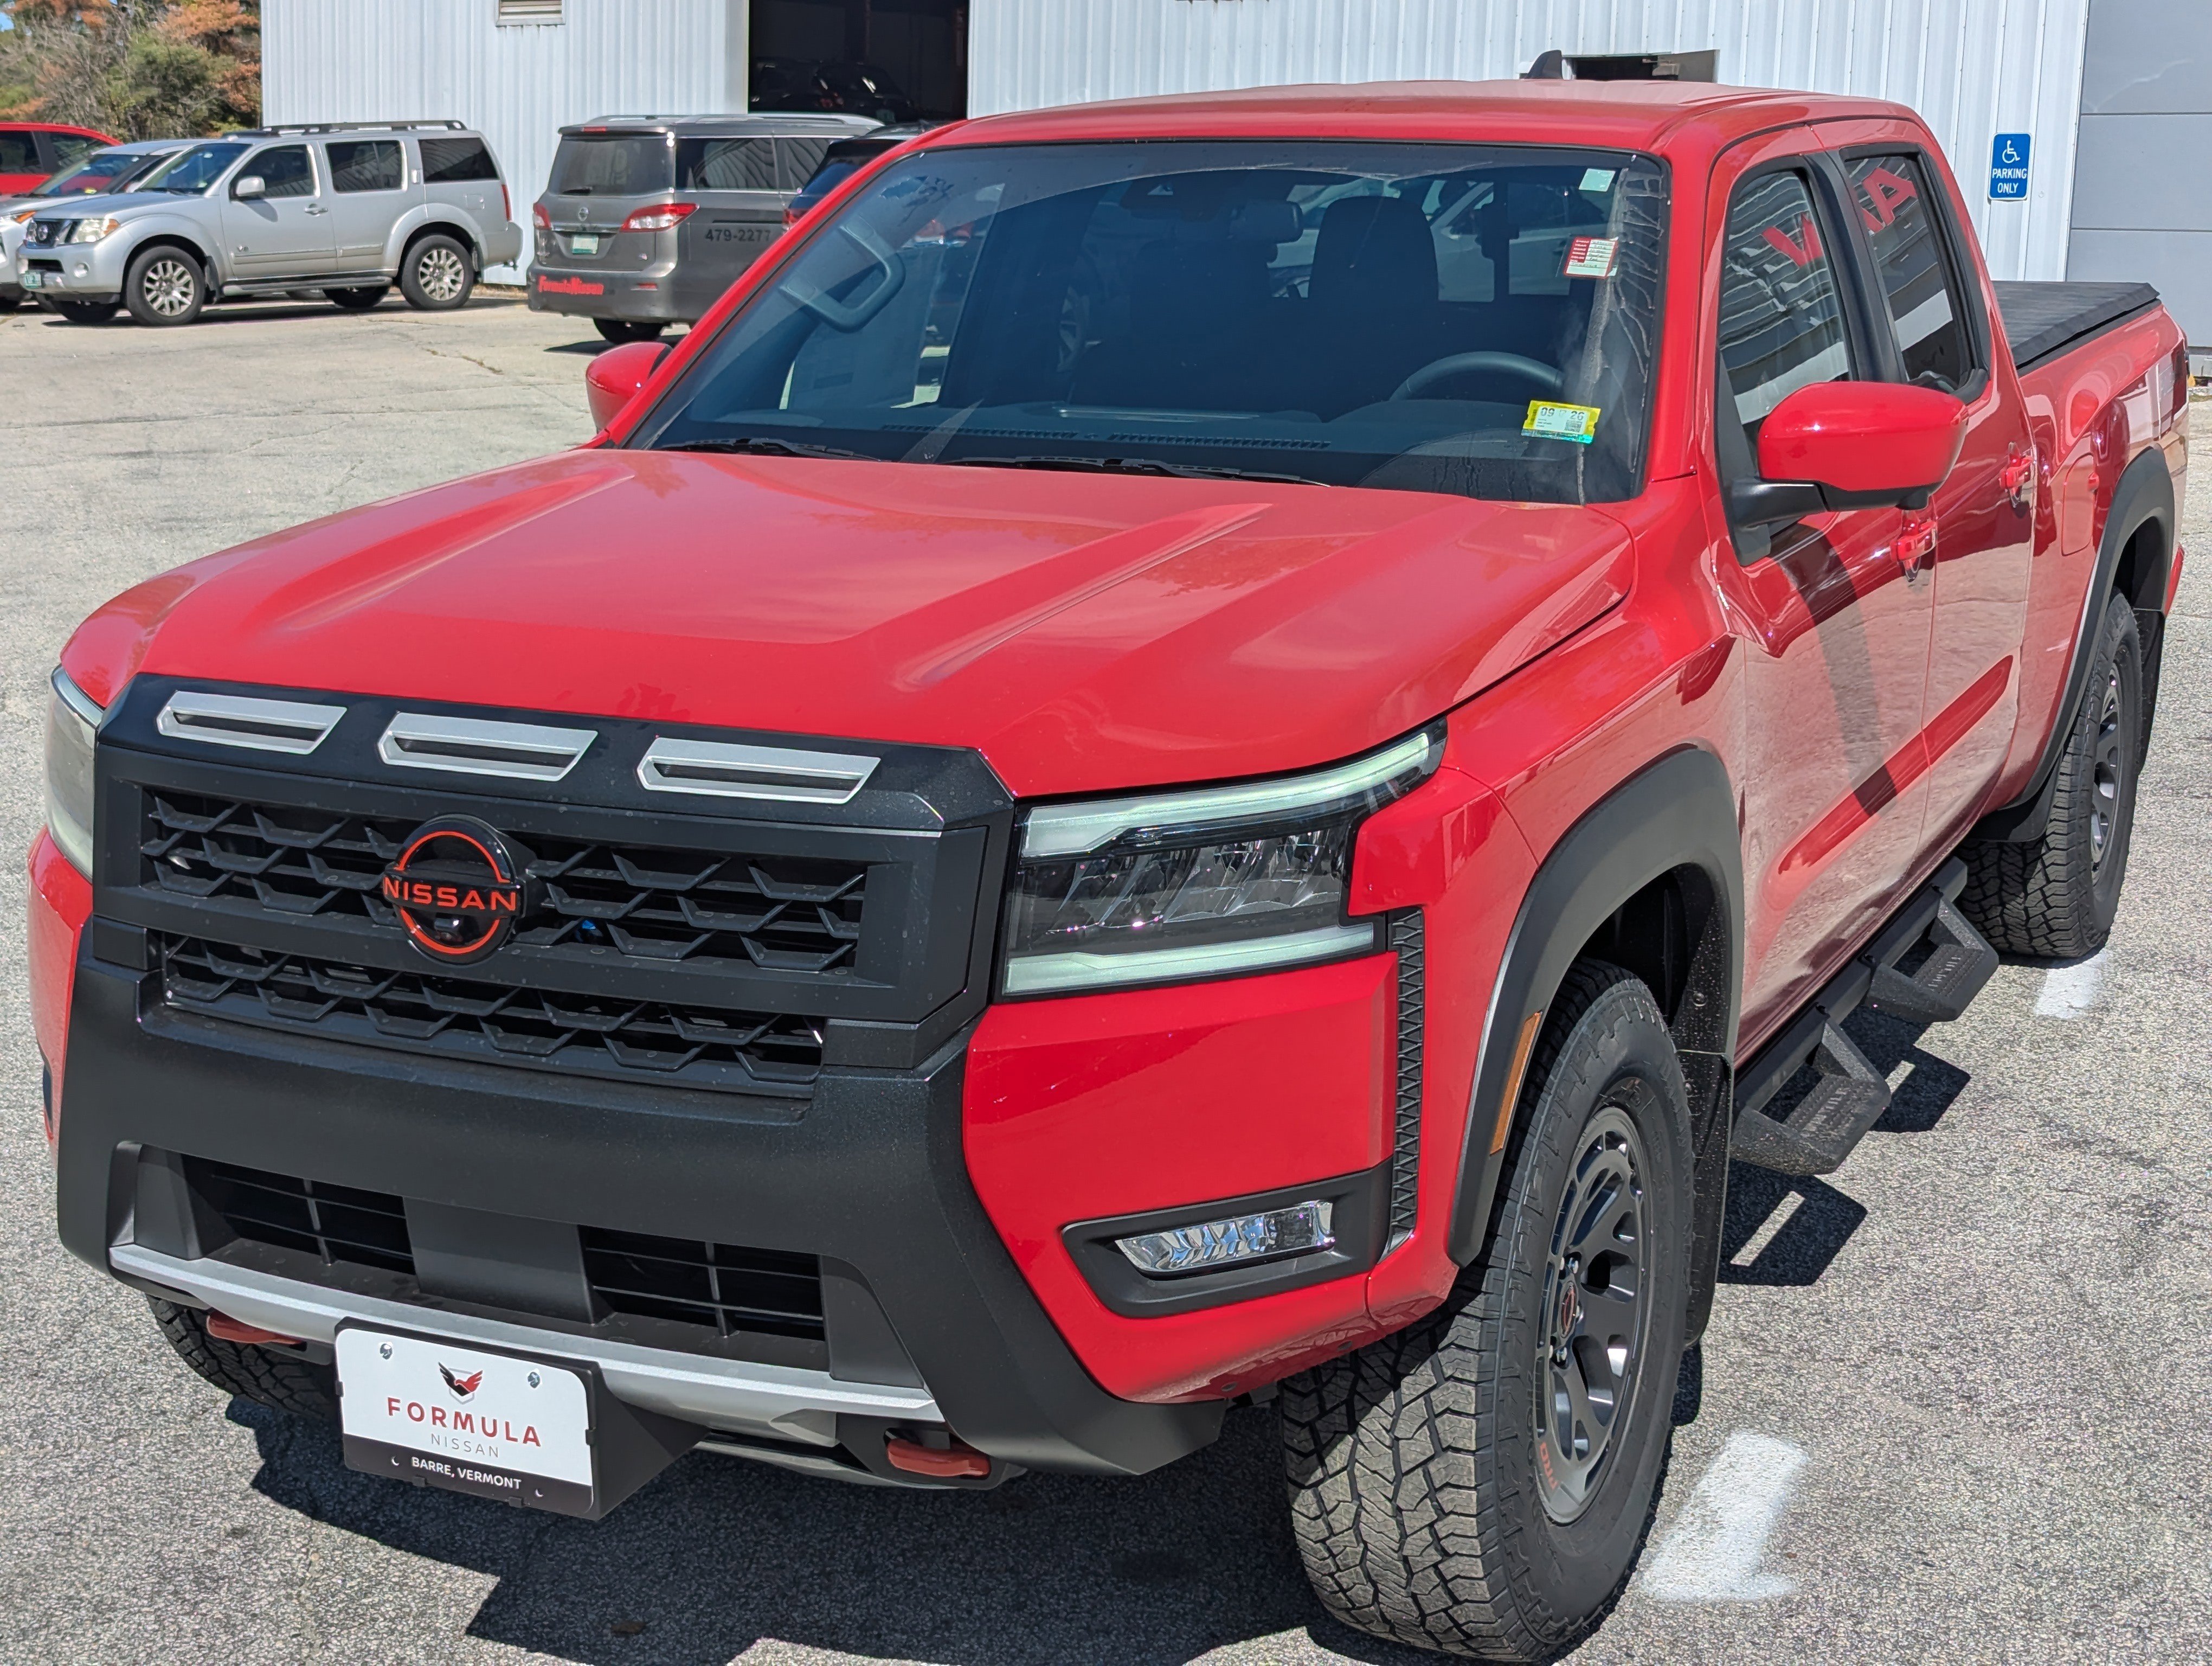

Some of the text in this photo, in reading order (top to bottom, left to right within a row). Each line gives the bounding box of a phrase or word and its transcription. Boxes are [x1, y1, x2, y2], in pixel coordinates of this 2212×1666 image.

[1992, 169, 2027, 179] PARKING
[1997, 182, 2019, 194] ONLY
[705, 229, 771, 242] 479-2277
[1541, 407, 1555, 416] 09
[1570, 411, 1584, 420] 26
[383, 876, 517, 912] NISSAN
[388, 1397, 541, 1446] FORMULA
[432, 1434, 499, 1457] NISSAN
[411, 1456, 522, 1490] BARRE, VERMONT
[1540, 1441, 1559, 1490] PRO
